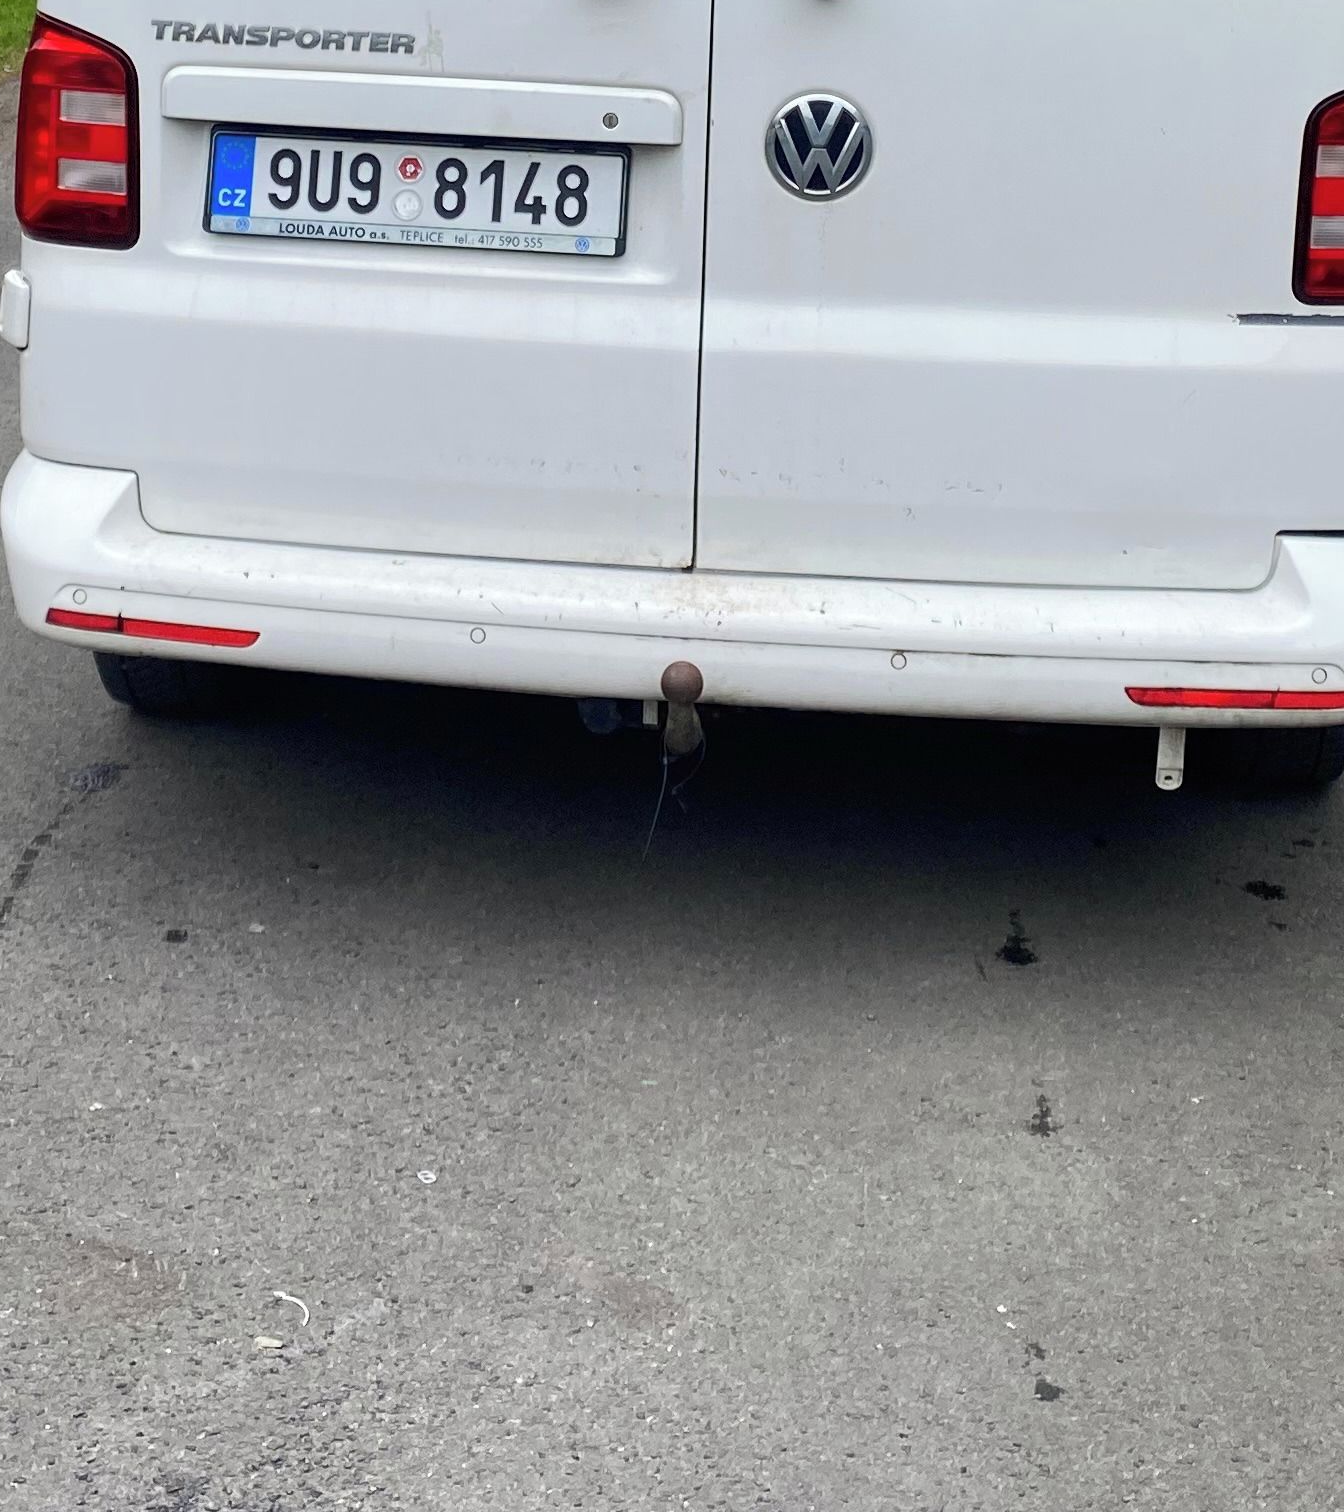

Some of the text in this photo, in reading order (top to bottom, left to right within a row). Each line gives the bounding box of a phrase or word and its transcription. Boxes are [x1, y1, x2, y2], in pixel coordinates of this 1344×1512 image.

[151, 19, 415, 54] TRANSPORTER
[217, 188, 246, 208] CZ
[267, 148, 590, 227] 9U9 8148
[278, 222, 325, 236] LOUDA
[328, 225, 366, 238] AUTO
[369, 231, 390, 240] a.s.
[400, 230, 444, 243] TEPLICE
[477, 234, 496, 246] 417
[498, 235, 521, 248] 590
[523, 237, 544, 249] 555
